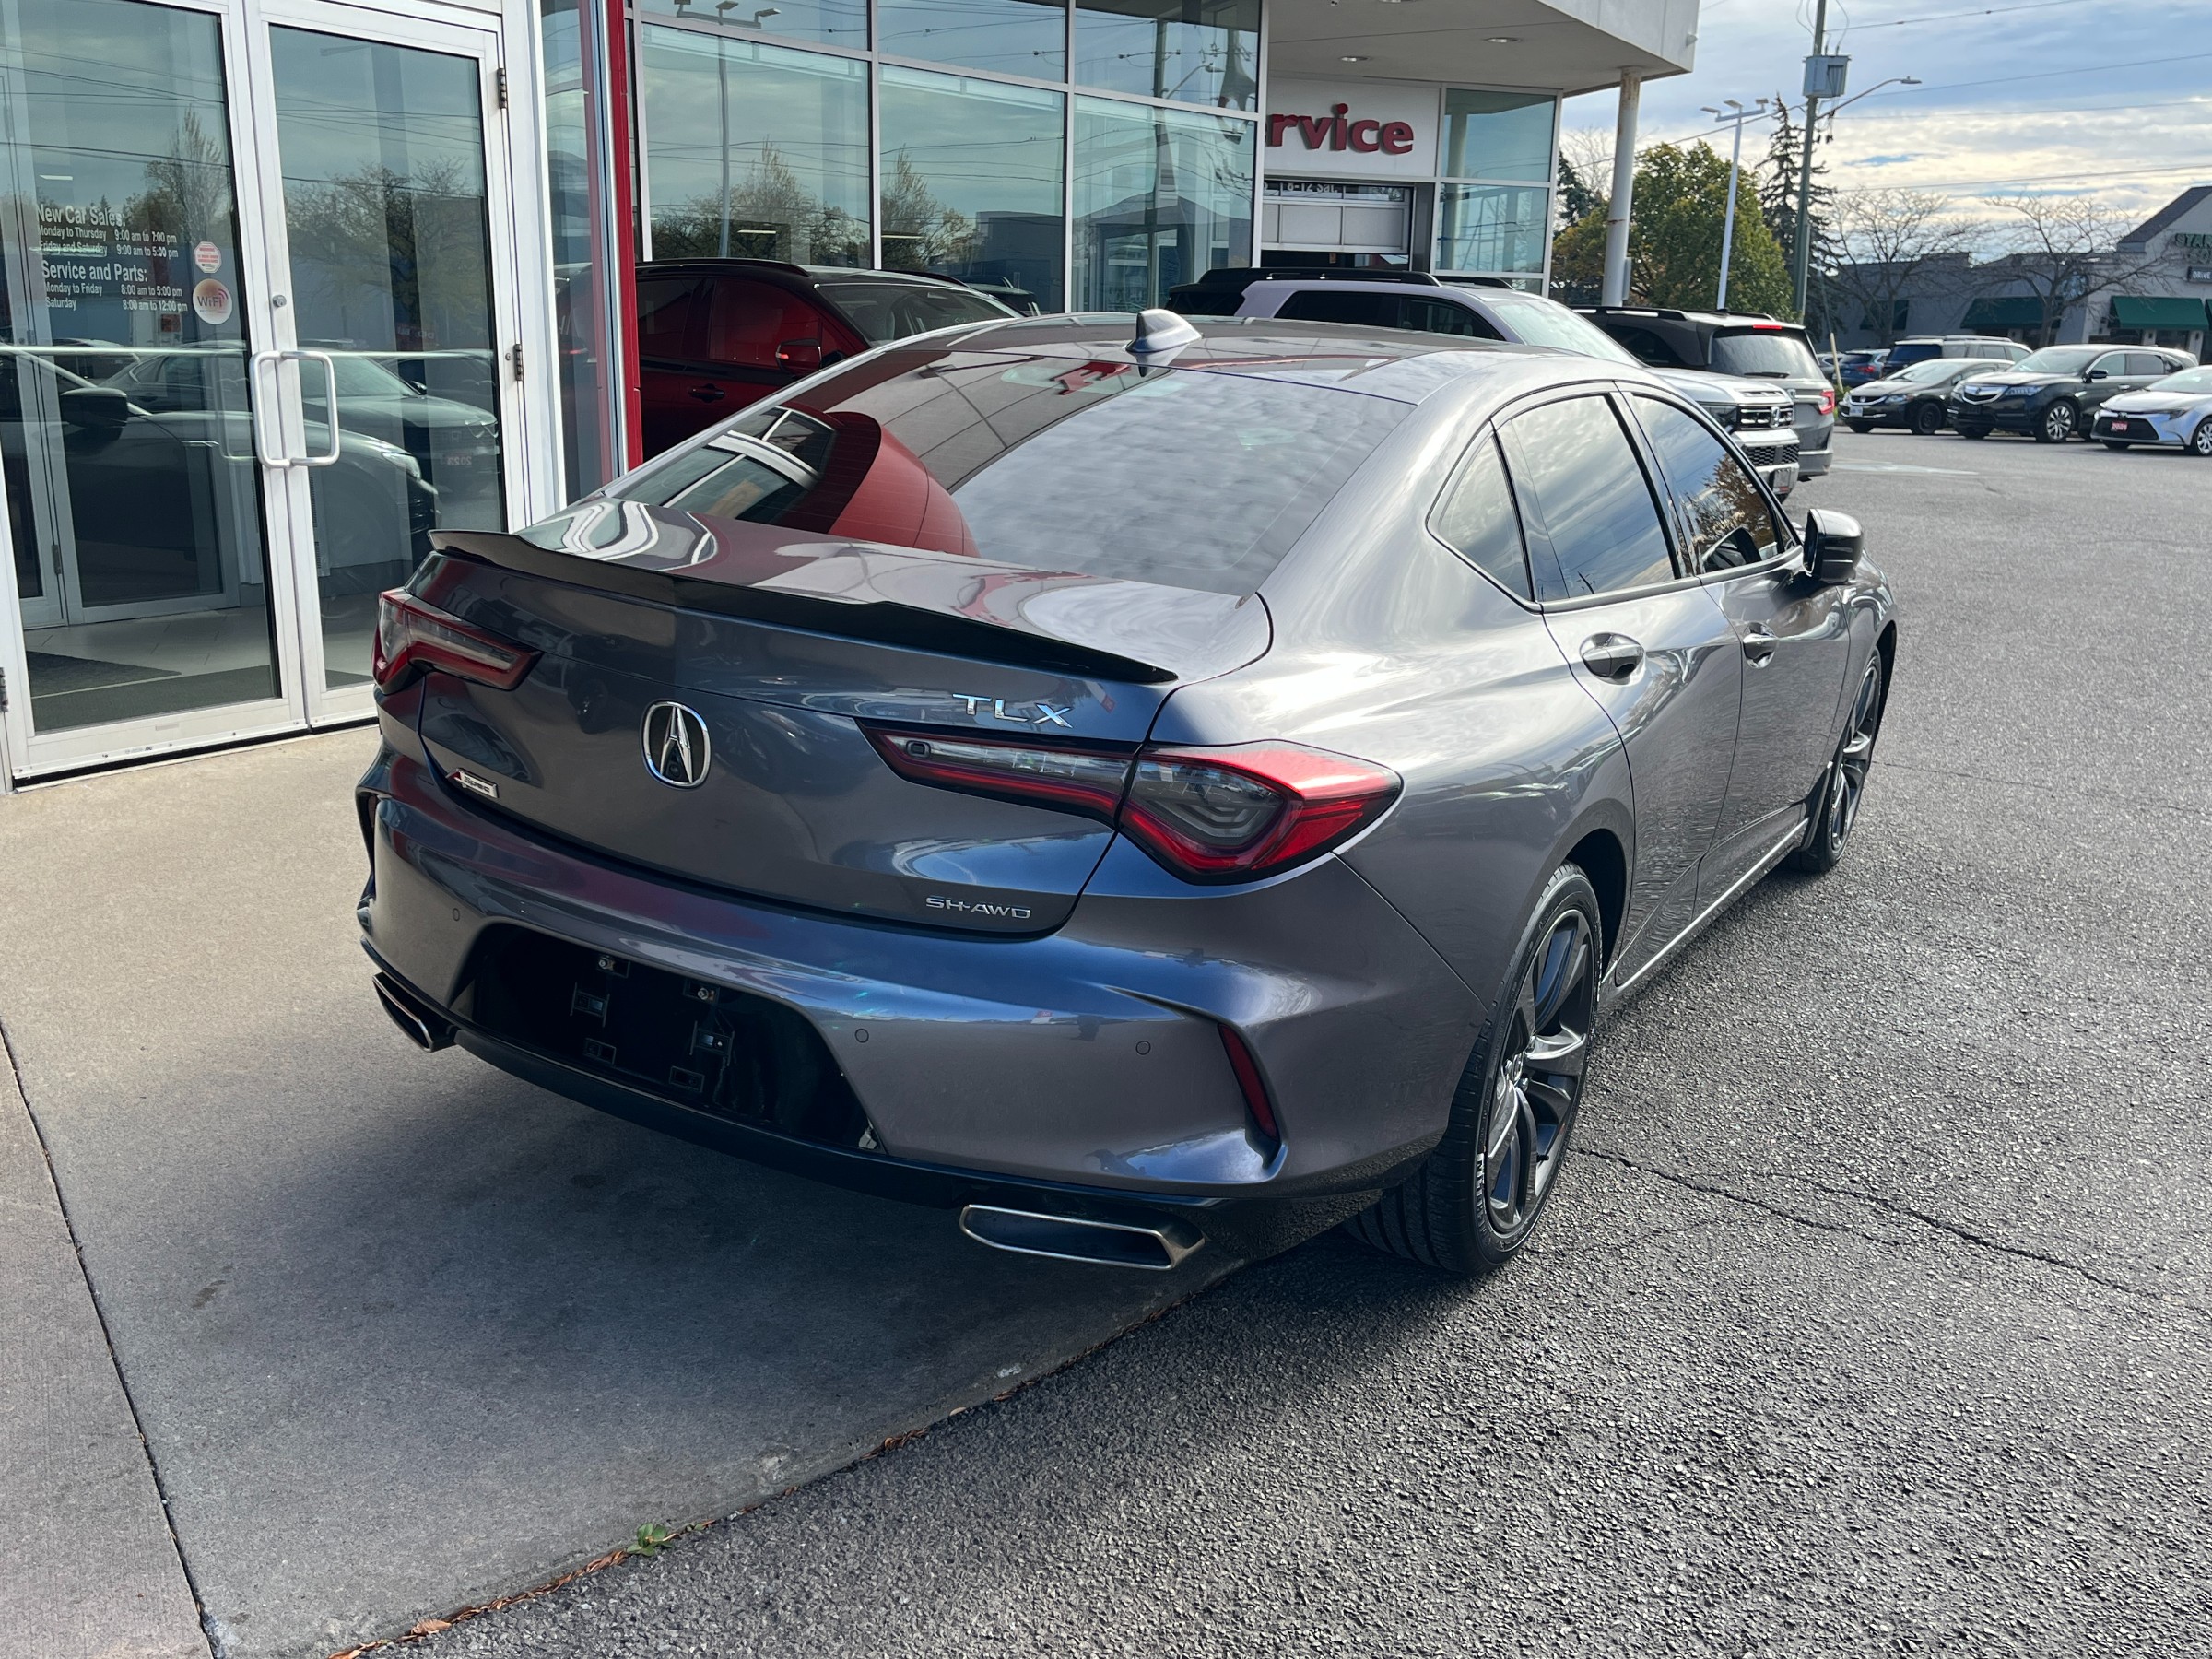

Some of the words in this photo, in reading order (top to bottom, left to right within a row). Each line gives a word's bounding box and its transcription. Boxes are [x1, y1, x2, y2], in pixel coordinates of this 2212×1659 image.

[1265, 102, 1415, 155] rvice
[37, 204, 63, 223] New
[65, 206, 87, 224] Car
[89, 206, 126, 227] Sales:
[39, 225, 65, 240] Monday
[65, 227, 74, 238] to
[75, 226, 106, 241] Thursday
[114, 229, 130, 241] 9:00
[131, 232, 142, 241] am
[142, 230, 150, 241] to
[167, 234, 177, 246] pm
[40, 241, 62, 255] Friday
[62, 241, 76, 253] and
[76, 241, 108, 257] Saturday
[116, 244, 132, 256] 9:00
[133, 247, 144, 256] am
[144, 246, 152, 256] to
[152, 246, 167, 258] 5:00
[168, 249, 179, 260] pm
[41, 259, 87, 280] Service
[88, 263, 112, 281] and
[113, 263, 148, 283] Parts:
[44, 281, 71, 296] Monday
[72, 282, 80, 294] to
[80, 282, 103, 297] Friday
[121, 284, 136, 296] 8:00
[137, 287, 148, 296] am
[148, 285, 156, 296] to
[156, 285, 171, 297] 5:00
[172, 288, 183, 300] pm
[45, 296, 77, 312] Saturday
[123, 299, 138, 311] 8:00
[138, 301, 149, 311] am
[149, 300, 158, 311] to
[158, 300, 177, 312] 12:00
[177, 302, 188, 314] pm
[952, 693, 1074, 729] TLX
[925, 896, 1031, 919] SH-AWD
